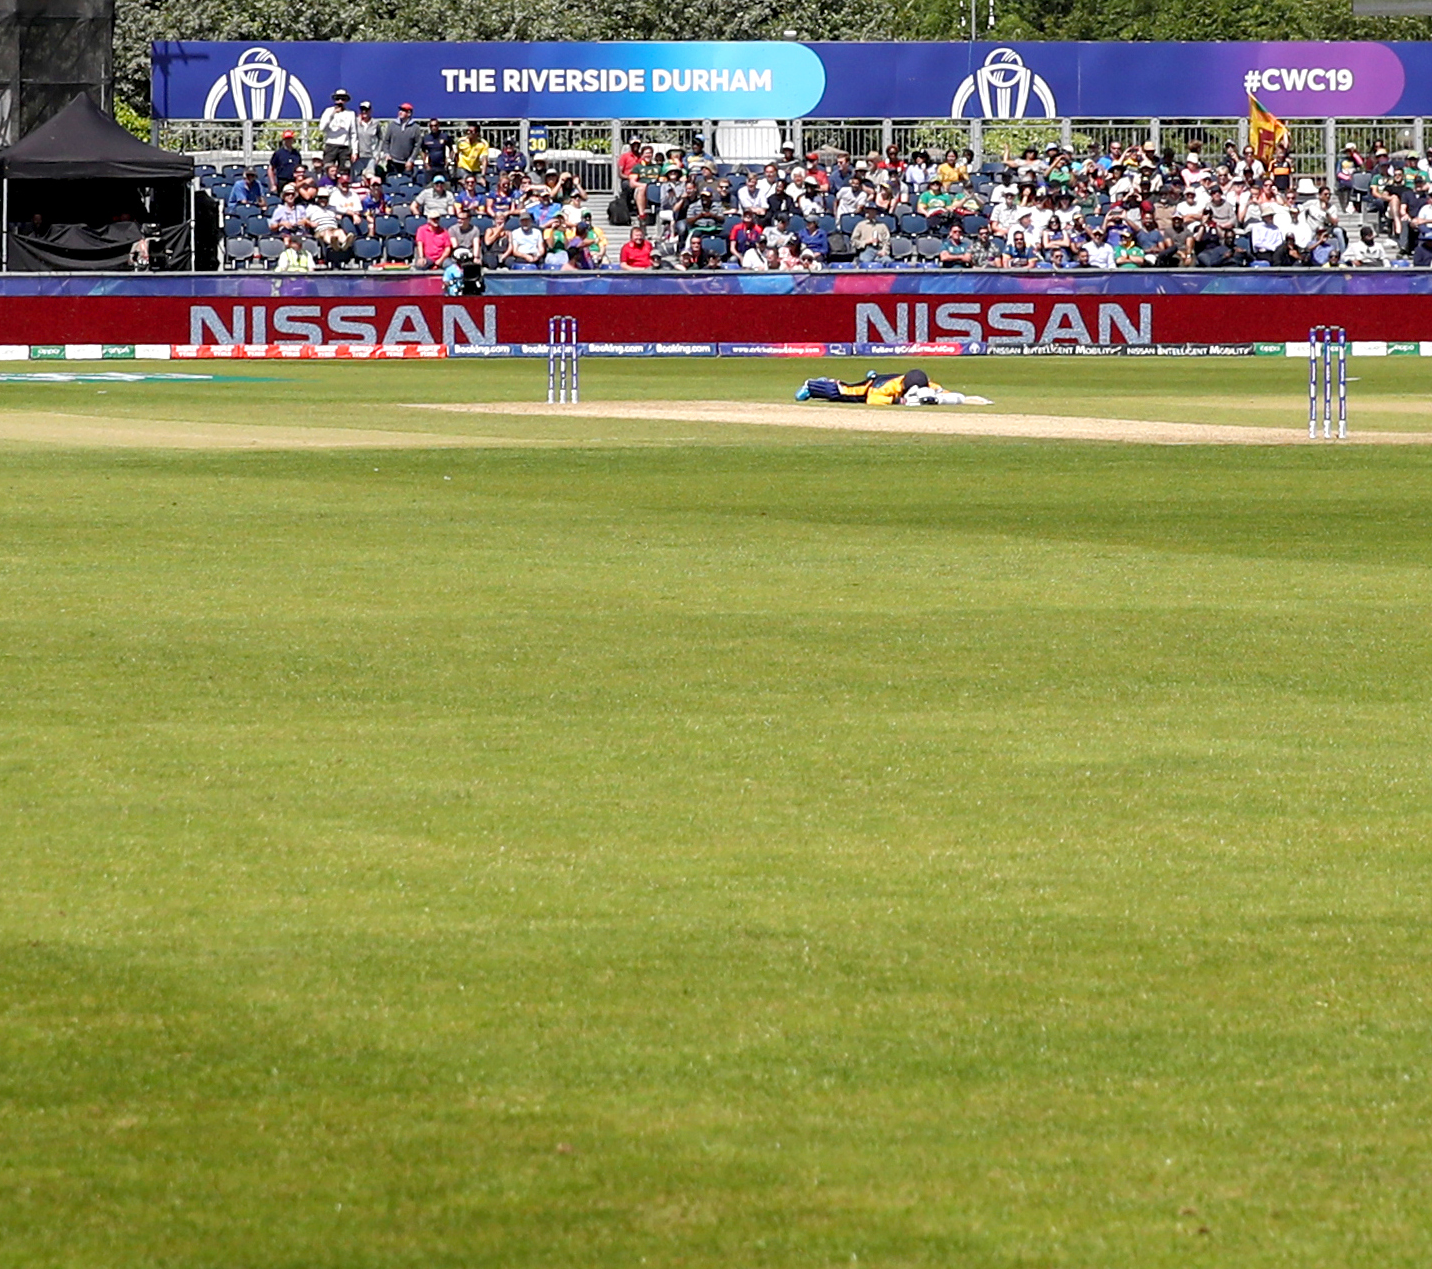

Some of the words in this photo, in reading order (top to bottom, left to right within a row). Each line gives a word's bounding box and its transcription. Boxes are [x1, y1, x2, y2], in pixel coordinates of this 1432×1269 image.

[441, 69, 496, 92] THE
[503, 69, 645, 92] RIVERSIDE
[652, 69, 772, 92] DURHAM
[1244, 68, 1353, 92] #CWC19
[528, 137, 546, 151] 30
[189, 304, 497, 345] NISSAN
[855, 302, 1152, 342] NISSAN
[454, 345, 511, 356] Booking.com
[588, 344, 644, 355] Booking.com
[656, 343, 711, 355] Booking.com
